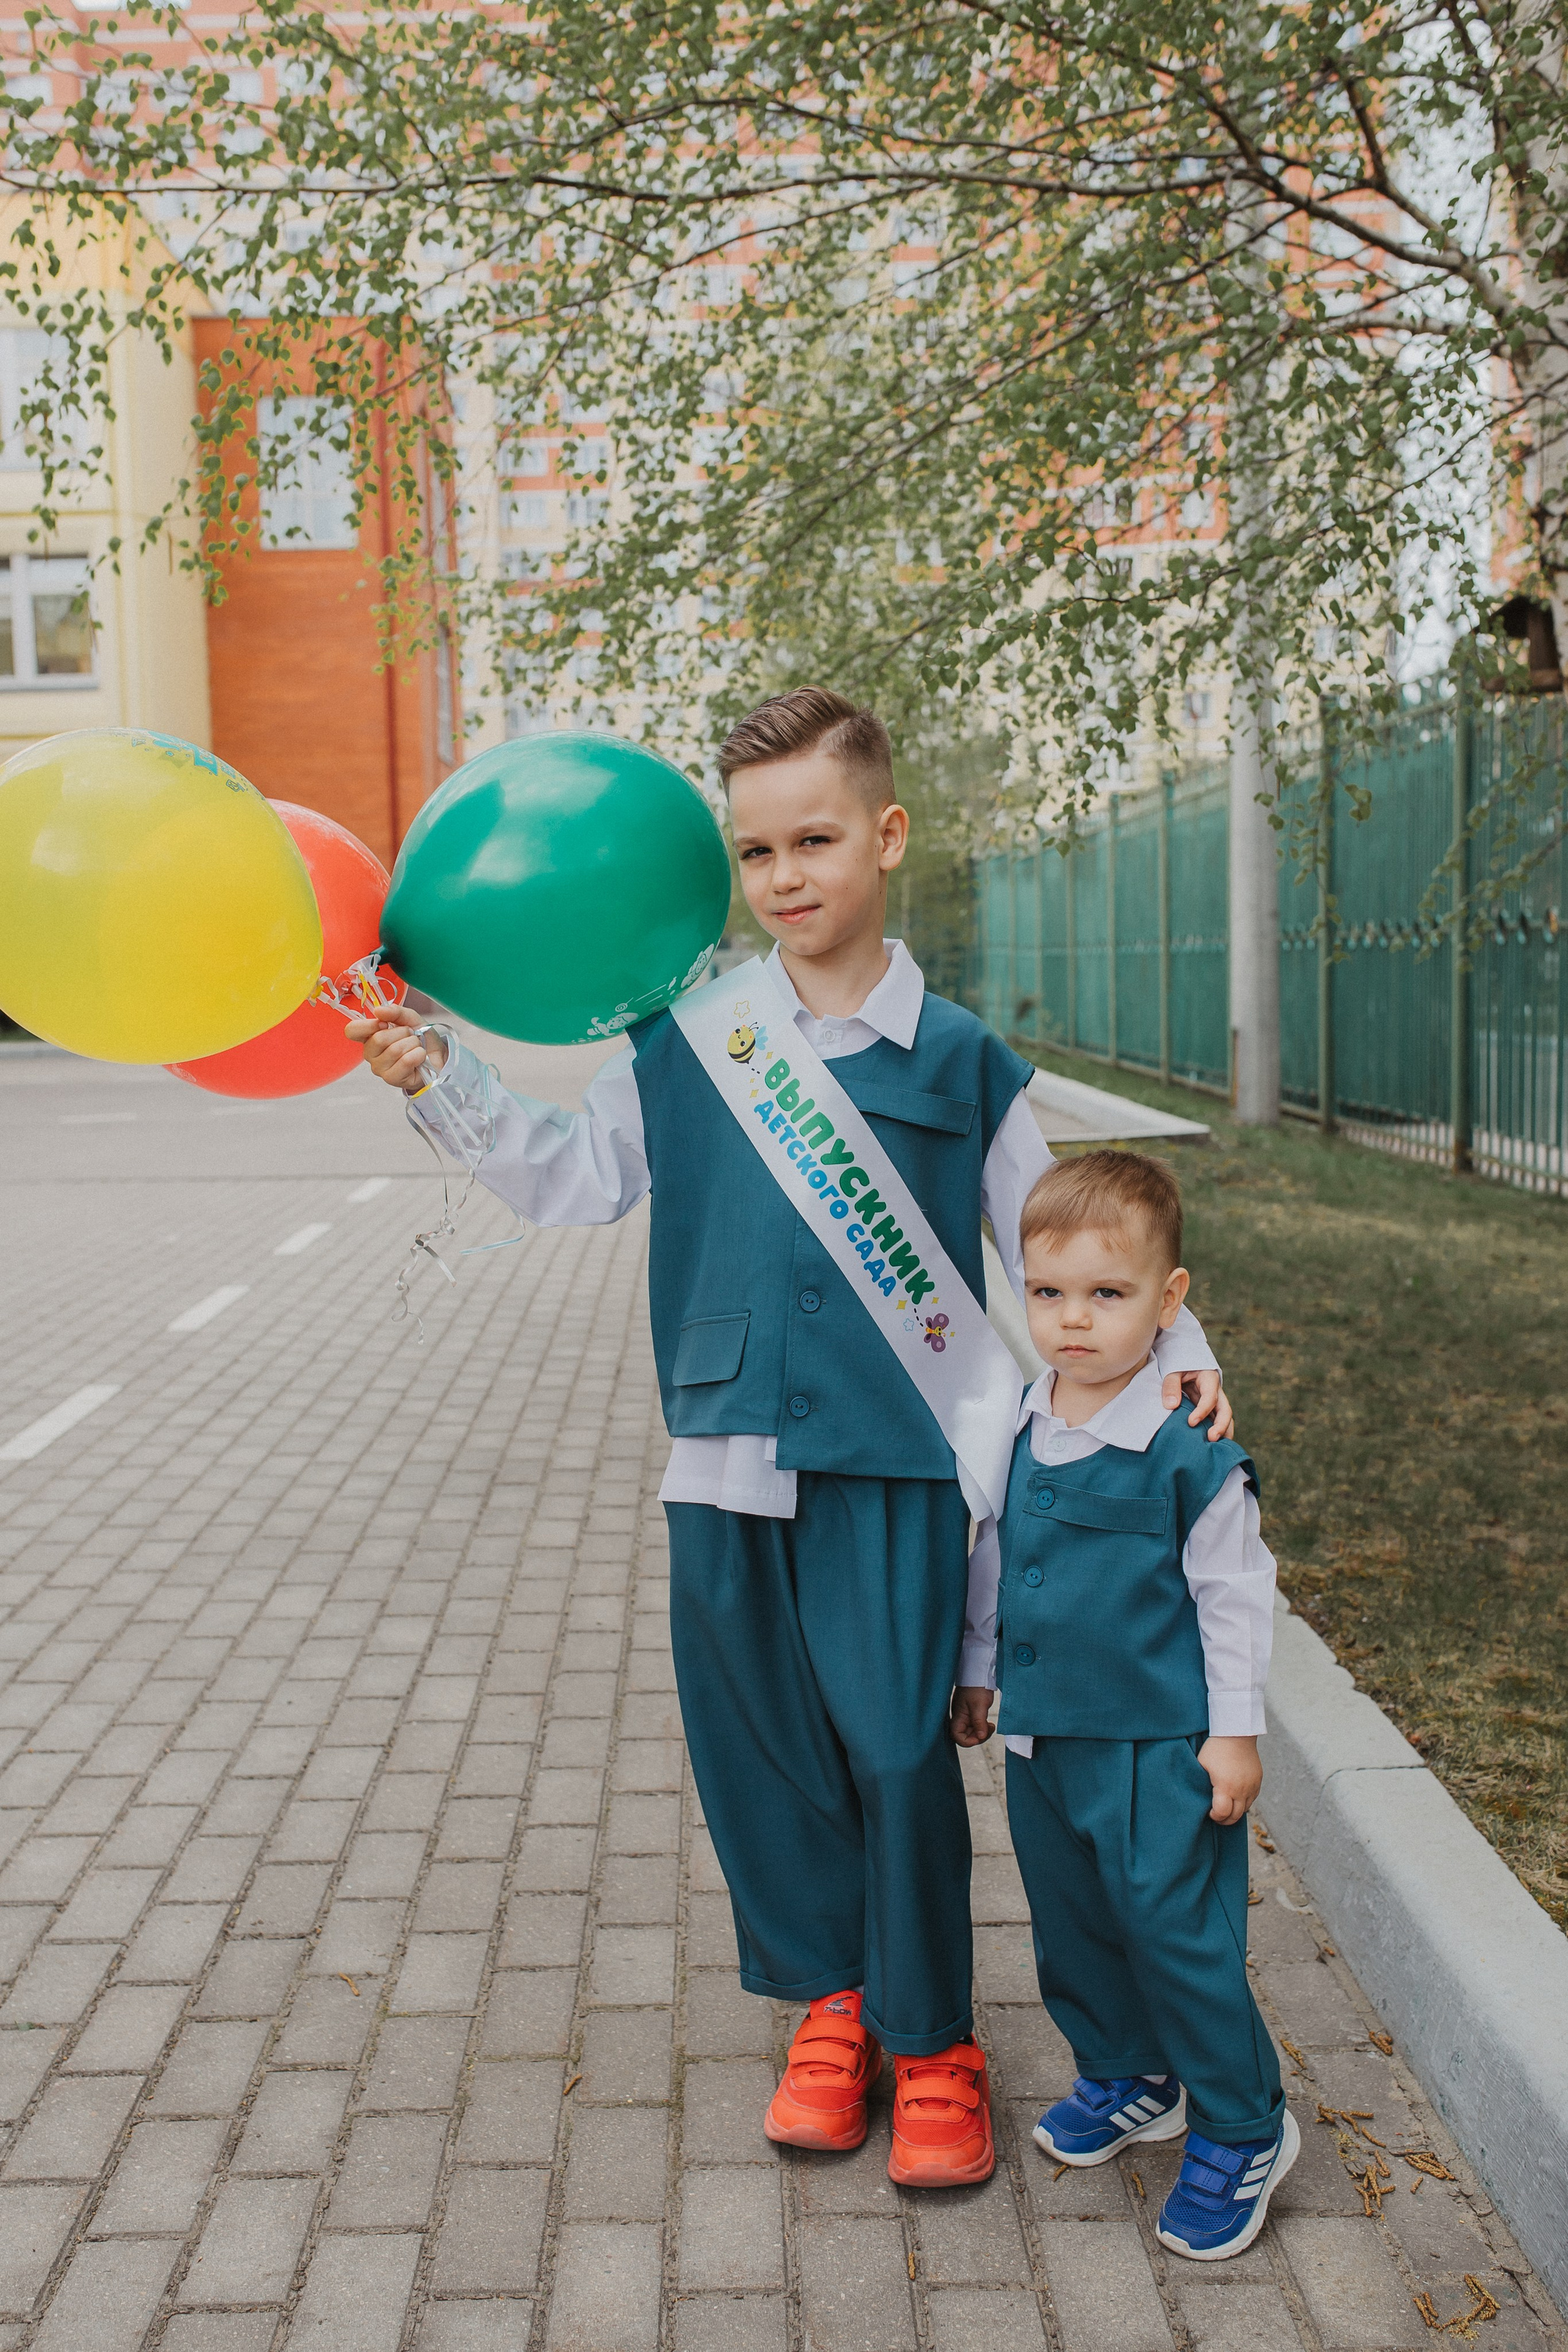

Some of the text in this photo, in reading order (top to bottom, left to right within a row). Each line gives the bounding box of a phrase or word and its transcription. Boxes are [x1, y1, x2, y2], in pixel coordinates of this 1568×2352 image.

[754, 1100, 896, 1297] ДЕТСКОГО САДА
[765, 1058, 935, 1305] ВЫПУСКНИК
